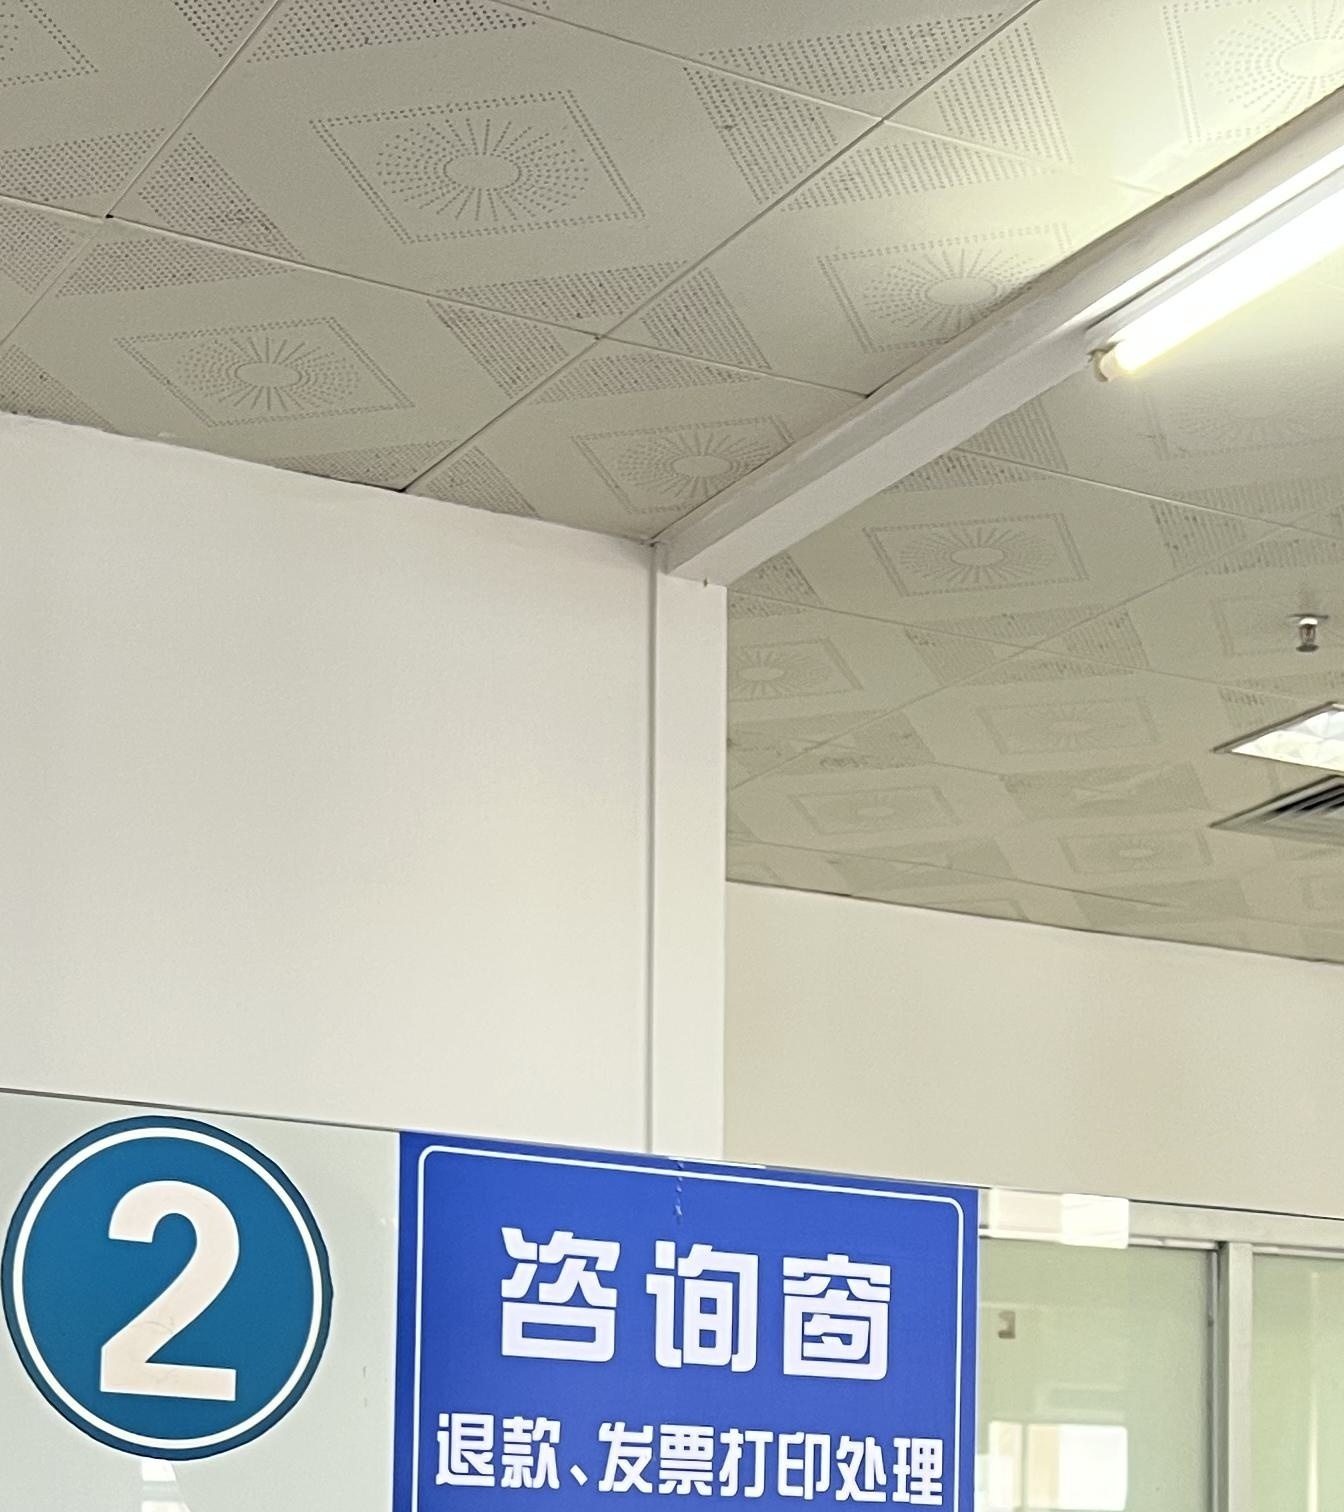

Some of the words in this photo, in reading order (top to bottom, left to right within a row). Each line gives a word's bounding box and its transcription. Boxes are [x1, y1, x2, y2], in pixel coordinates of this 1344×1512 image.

[100, 1180, 240, 1402] 2
[501, 1227, 891, 1381] 咨询窗
[435, 1412, 944, 1506] 退款、发票打印处理
